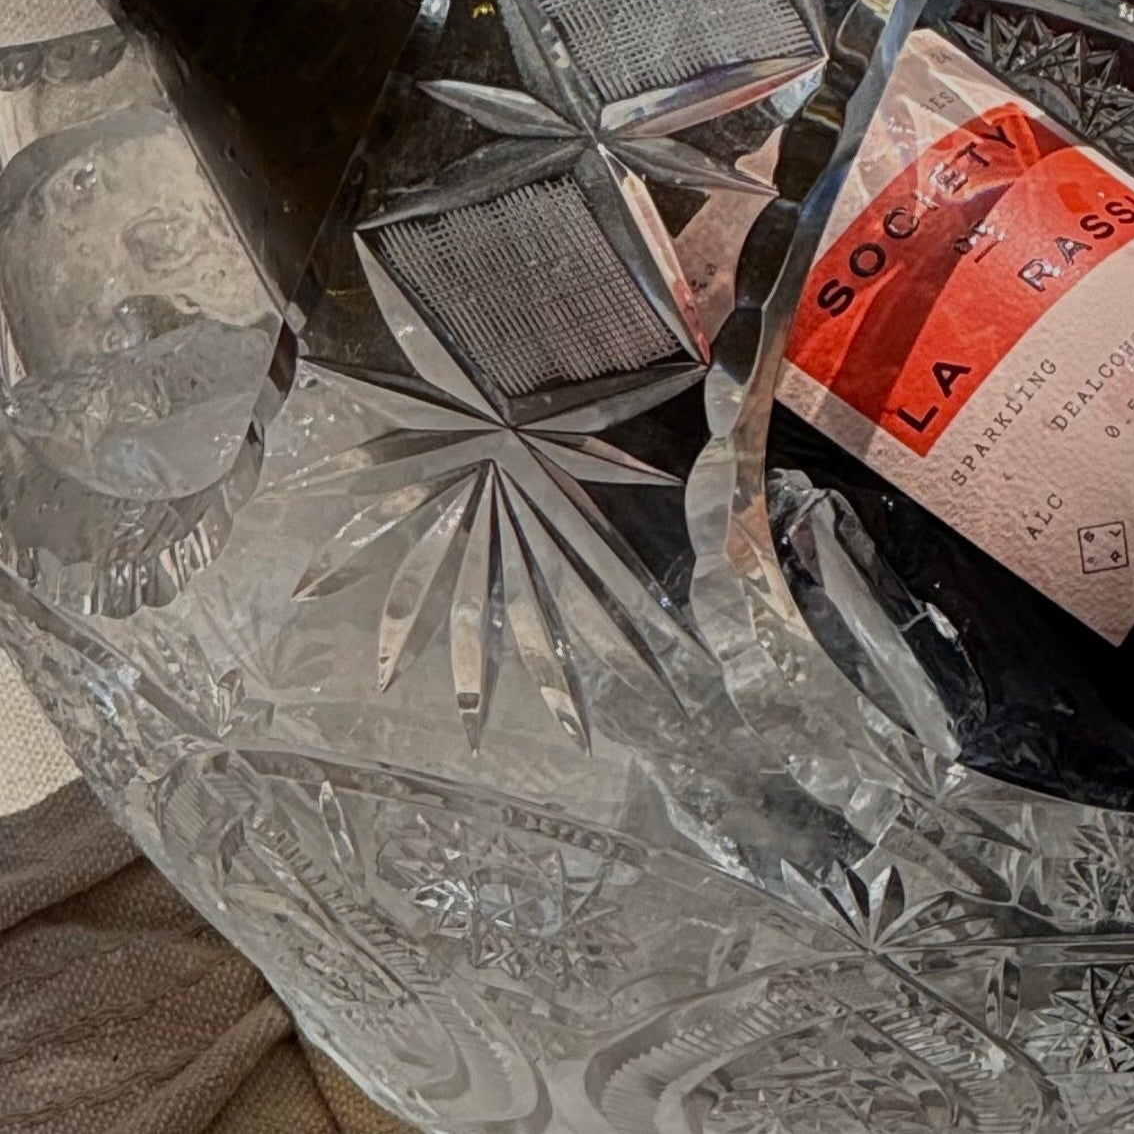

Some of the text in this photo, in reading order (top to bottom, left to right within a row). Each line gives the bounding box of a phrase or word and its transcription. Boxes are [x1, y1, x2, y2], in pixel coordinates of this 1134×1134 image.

[816, 124, 1017, 318] SOCIETY
[896, 360, 972, 433] LA
[951, 357, 1057, 487] SPARKLING
[1025, 492, 1064, 541] ALC
[1110, 550, 1122, 564] R
